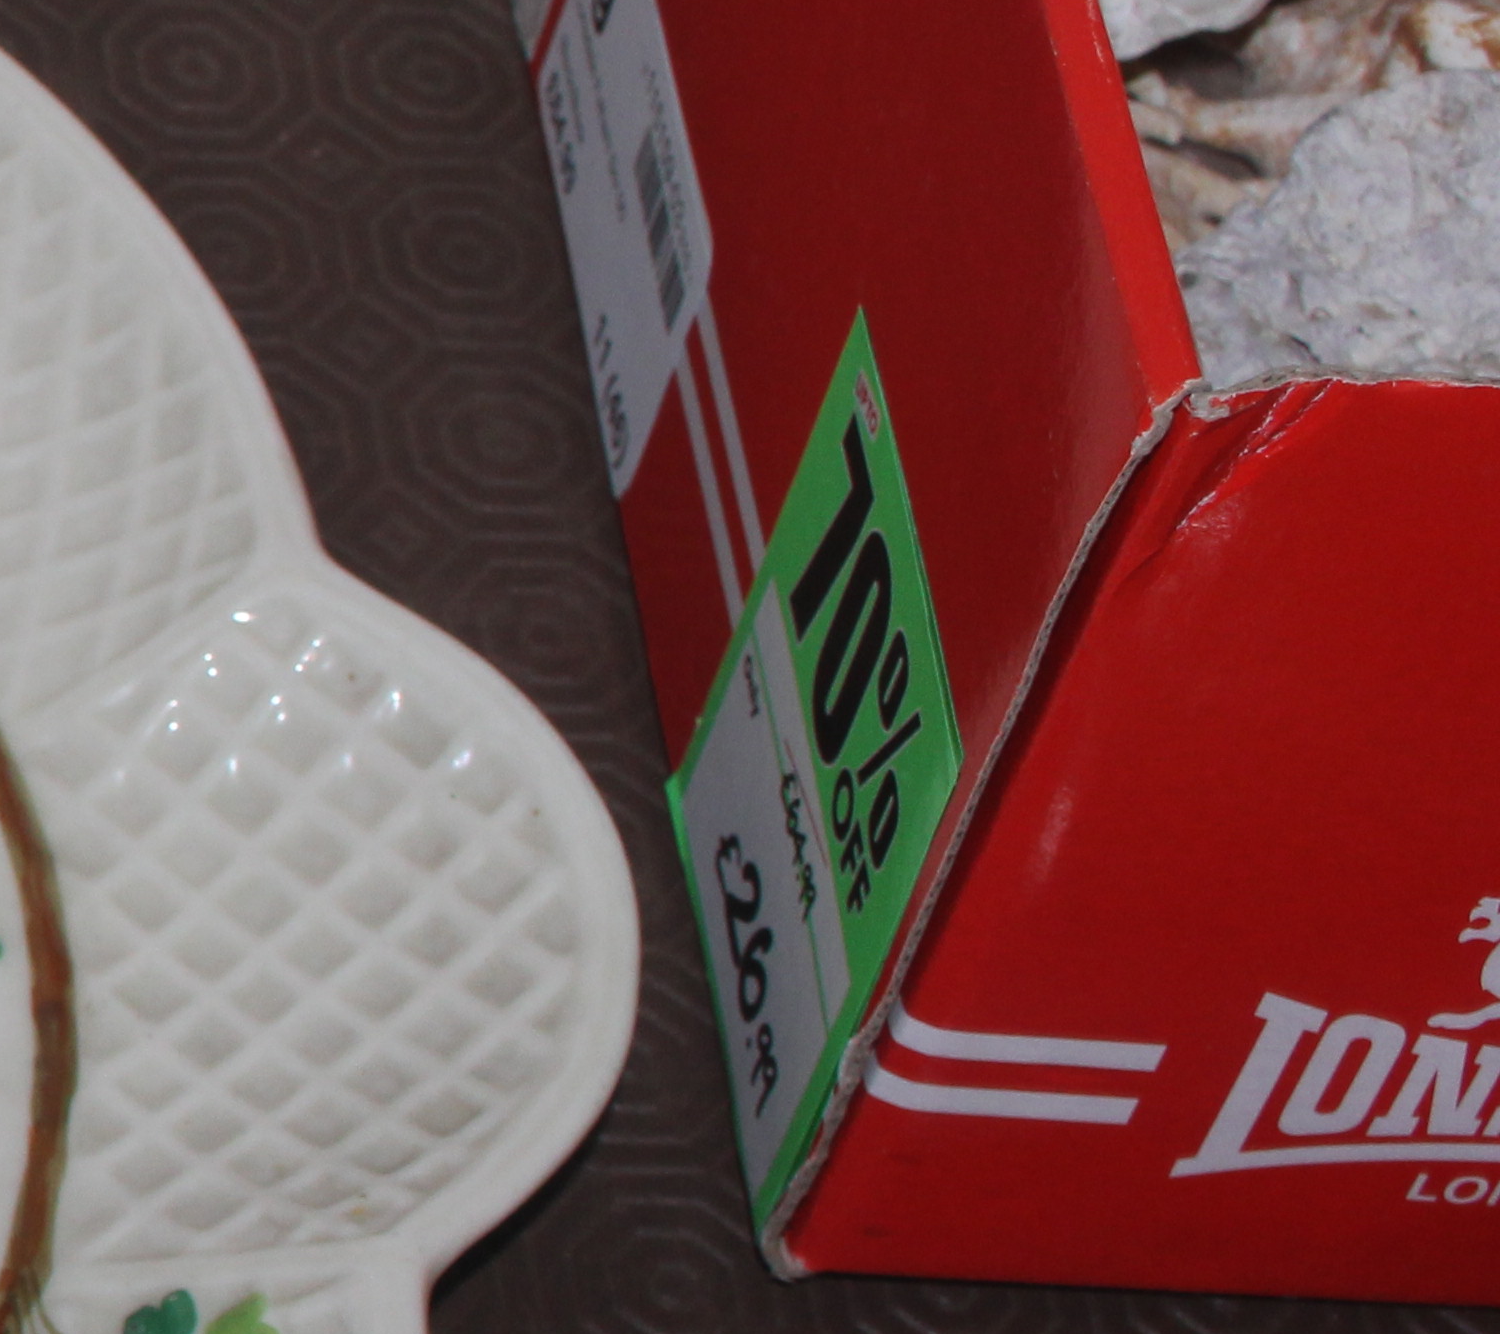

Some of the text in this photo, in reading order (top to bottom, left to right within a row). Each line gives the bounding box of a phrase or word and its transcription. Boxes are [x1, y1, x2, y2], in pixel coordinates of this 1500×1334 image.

[789, 412, 922, 870] 70%
[715, 833, 779, 1118] £26.99
[832, 768, 870, 914] OFF
